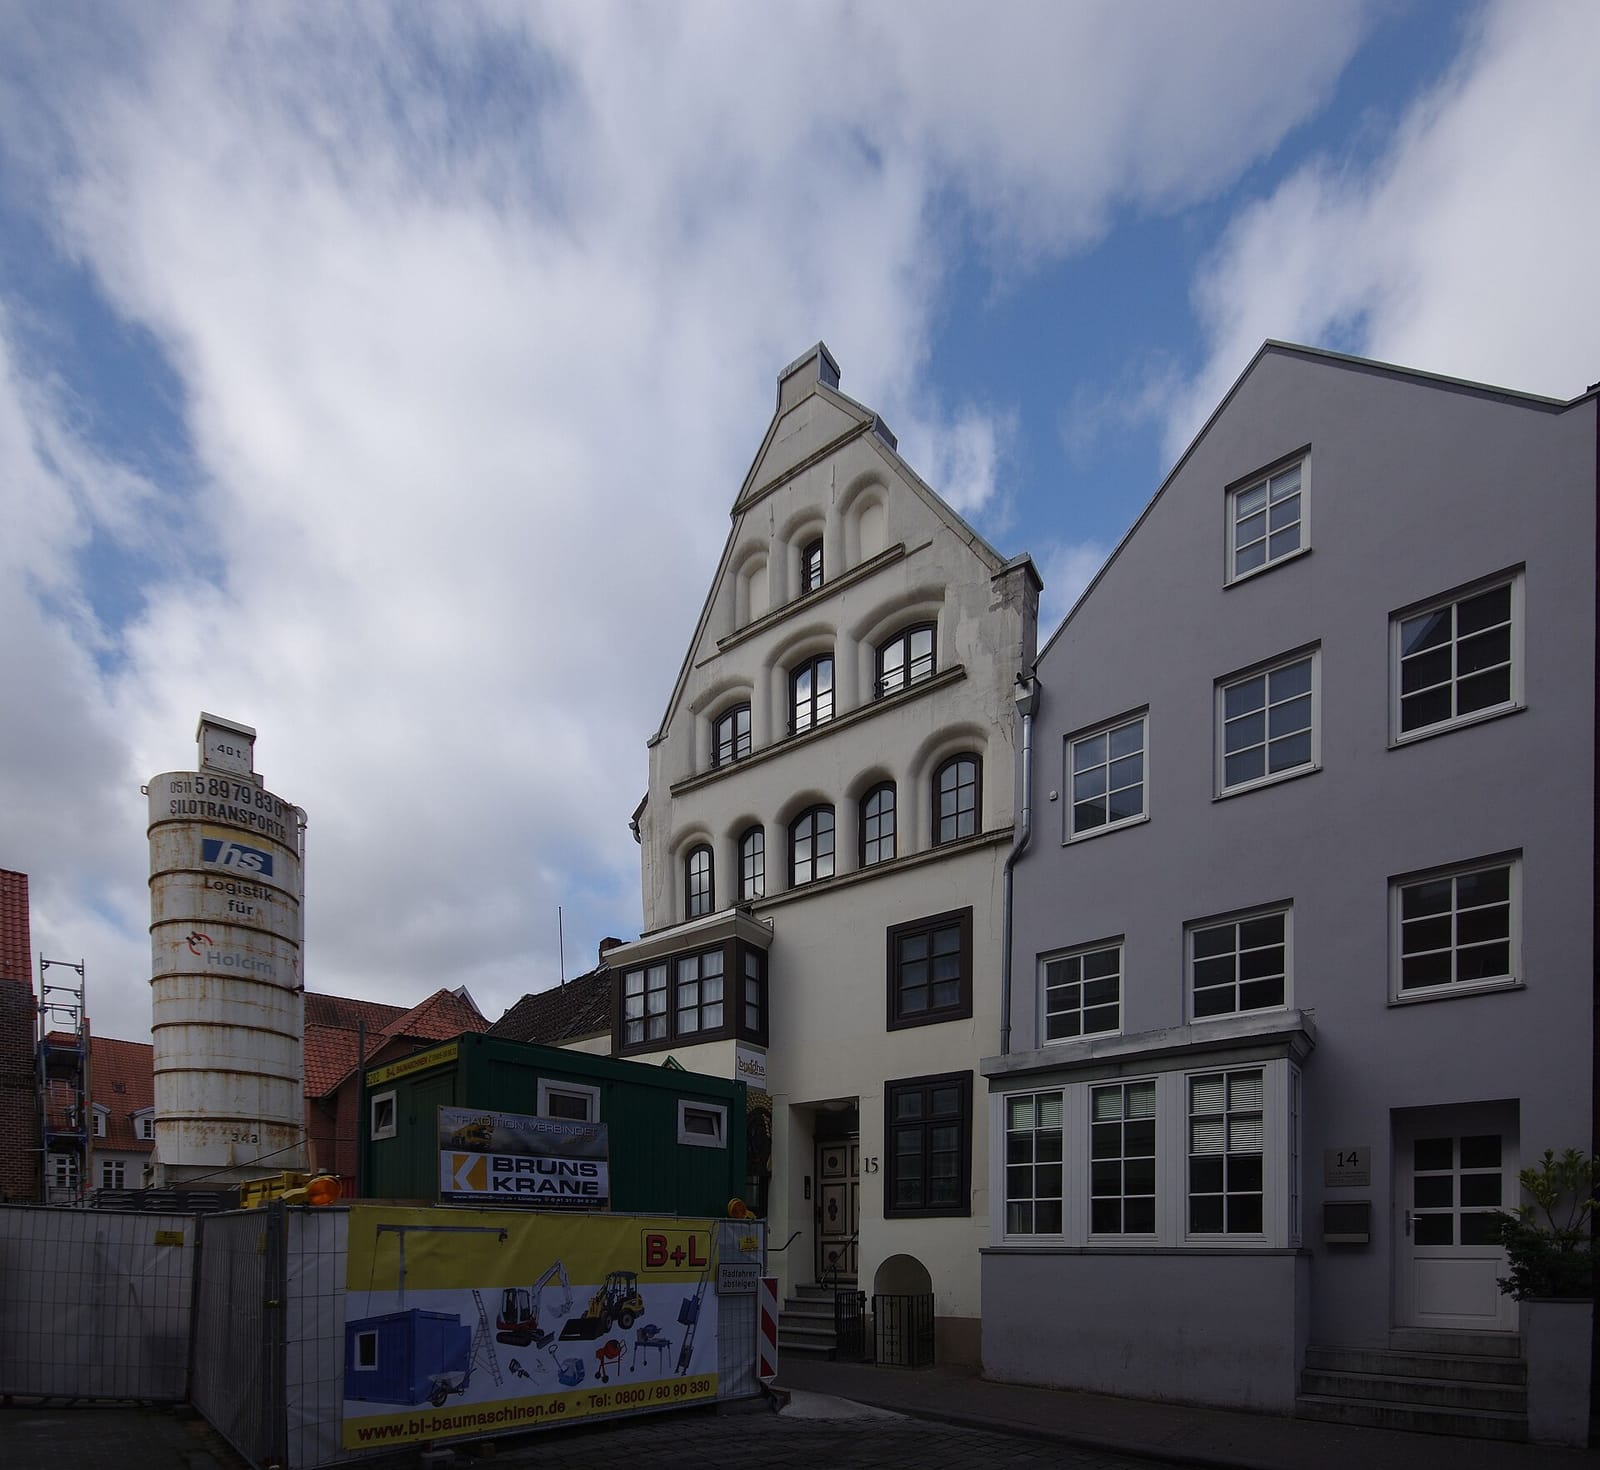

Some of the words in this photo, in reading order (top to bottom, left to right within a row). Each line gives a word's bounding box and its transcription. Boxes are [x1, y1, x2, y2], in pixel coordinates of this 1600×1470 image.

[217, 744, 233, 756] 40
[170, 799, 287, 840] SILOTRANSPORTE
[205, 875, 273, 902] Logistik
[228, 899, 253, 915] für
[455, 1114, 524, 1131] TRADITION
[529, 1120, 598, 1137] VERBINDET
[492, 1156, 598, 1178] BRUNS
[864, 1157, 878, 1173] 15
[1336, 1151, 1359, 1167] 14
[492, 1175, 599, 1196] KRANE
[646, 1234, 707, 1267] B+L
[722, 1269, 757, 1278] Radfahrer
[358, 1400, 566, 1441] www.bl-baumaschinen.de
[588, 1393, 611, 1408] Tel:
[615, 1389, 645, 1405] 0800
[655, 1385, 670, 1399] 90
[673, 1383, 687, 1396] 90
[690, 1380, 710, 1394] 330
